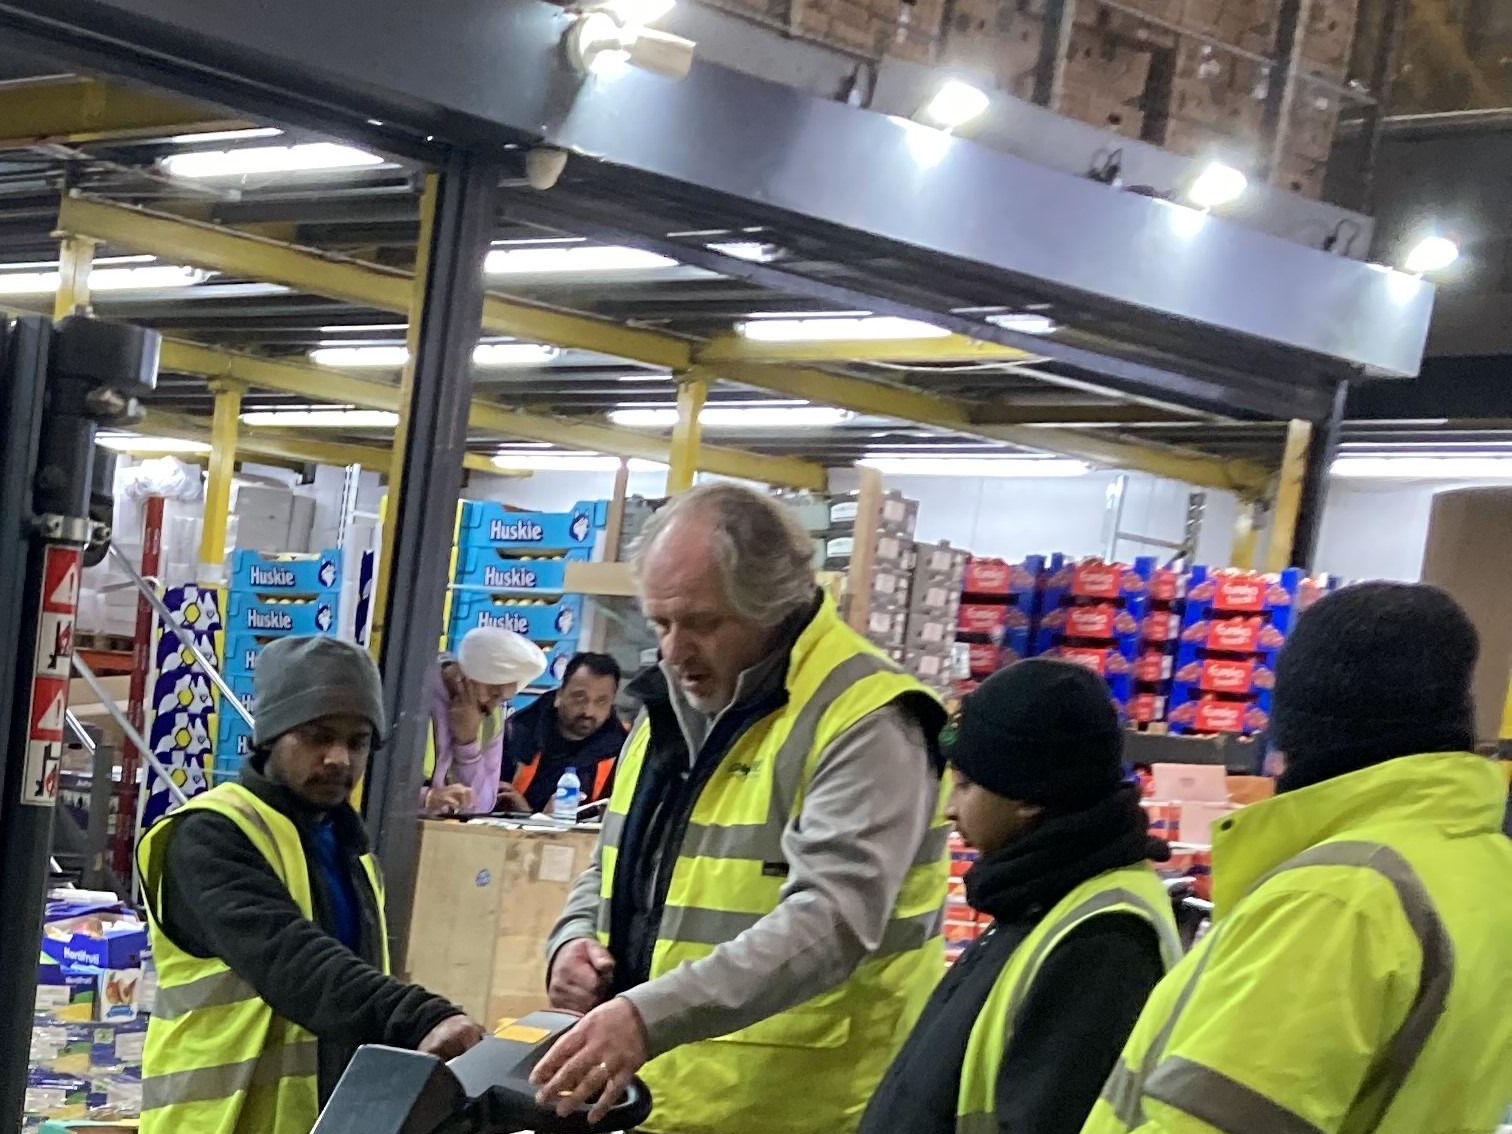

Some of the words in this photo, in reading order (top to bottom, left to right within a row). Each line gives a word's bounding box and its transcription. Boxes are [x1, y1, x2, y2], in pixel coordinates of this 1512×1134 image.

[490, 519, 543, 540] Huskie
[250, 565, 295, 586] Huskie
[485, 566, 536, 587] Huskie
[248, 609, 292, 629] Huskie
